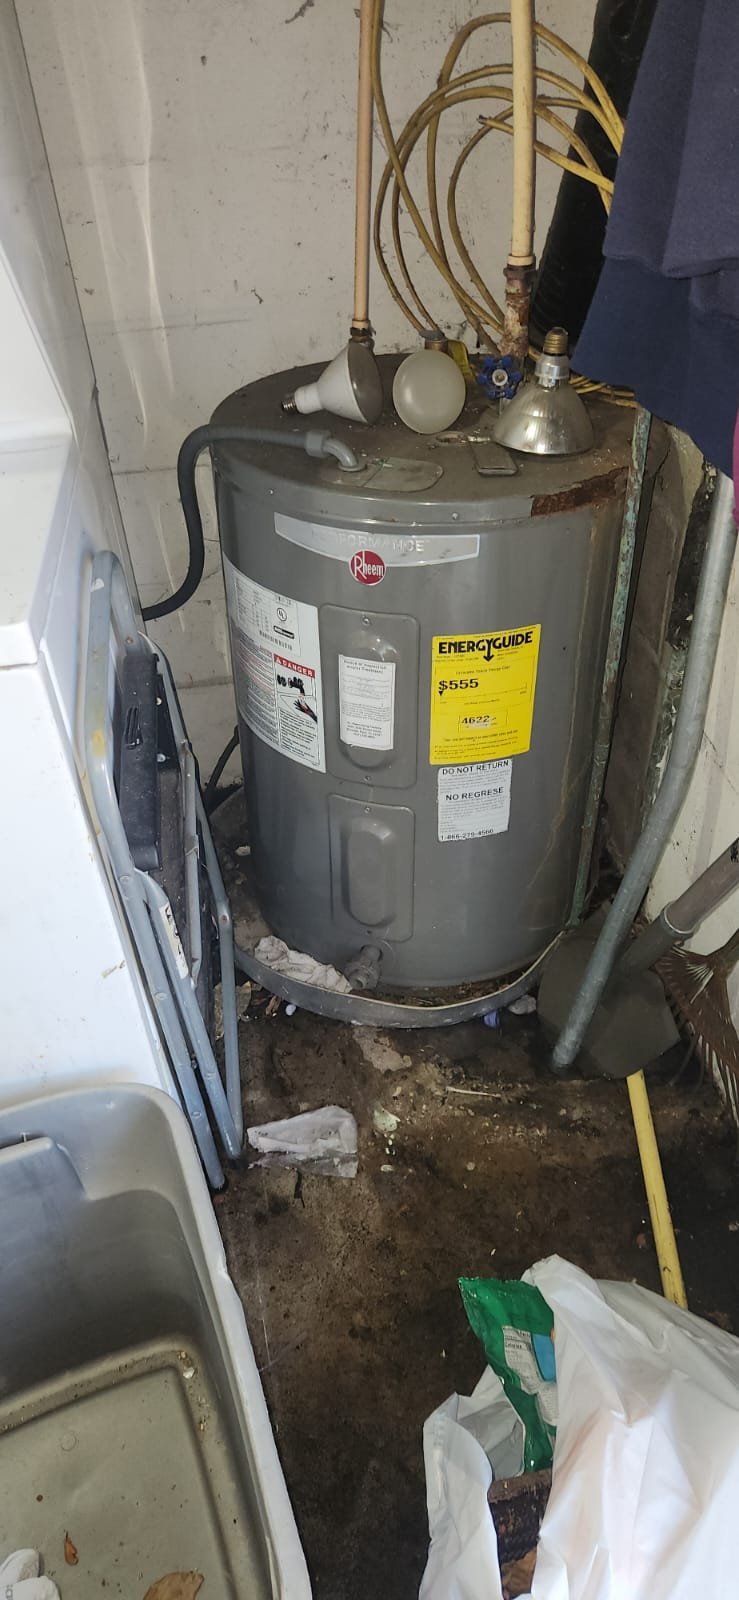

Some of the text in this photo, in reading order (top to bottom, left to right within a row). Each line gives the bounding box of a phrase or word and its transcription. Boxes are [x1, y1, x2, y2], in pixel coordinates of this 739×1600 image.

[354, 550, 384, 579] Rheem
[438, 631, 533, 655] ENERGYGUIDE
[282, 660, 313, 677] DANGER
[438, 679, 479, 691] $555
[457, 766, 474, 774] NOT
[477, 759, 509, 771] RETURN
[445, 787, 504, 801] NO REGRESE
